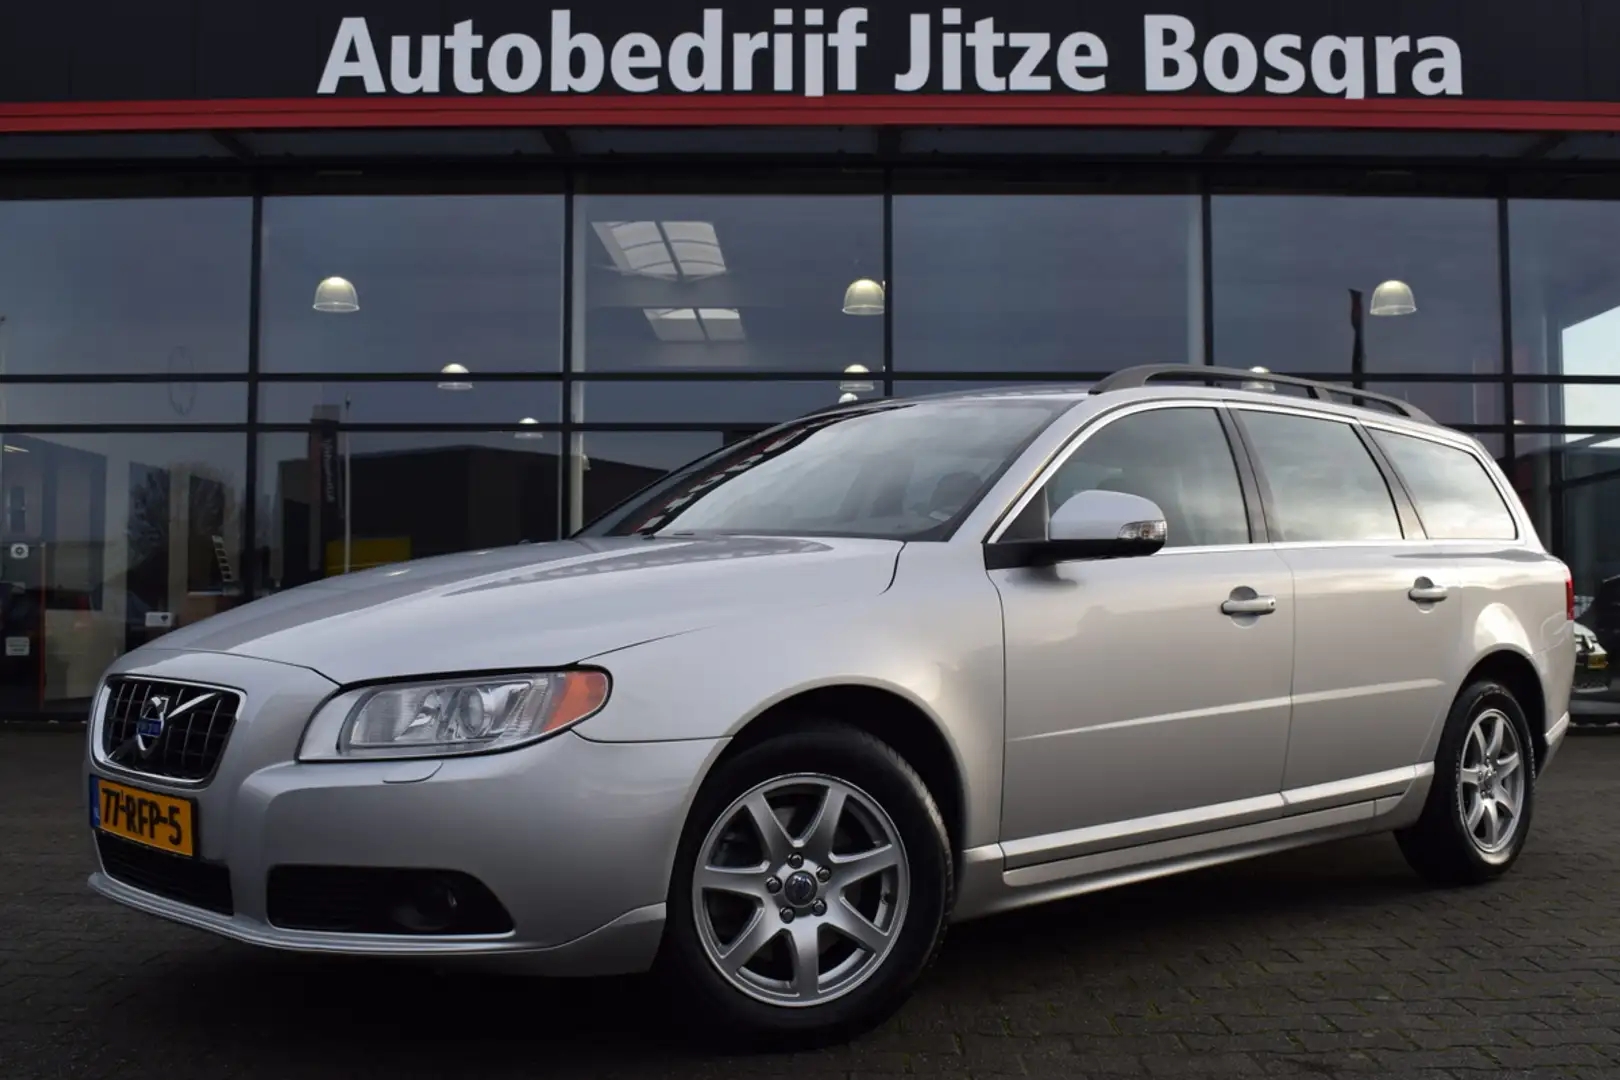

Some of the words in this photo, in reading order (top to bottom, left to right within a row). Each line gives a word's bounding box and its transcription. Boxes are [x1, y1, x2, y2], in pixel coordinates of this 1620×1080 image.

[316, 7, 868, 97] Autobedrijf
[894, 7, 1109, 92] Jitze
[101, 787, 183, 846] 77-RFP-5
